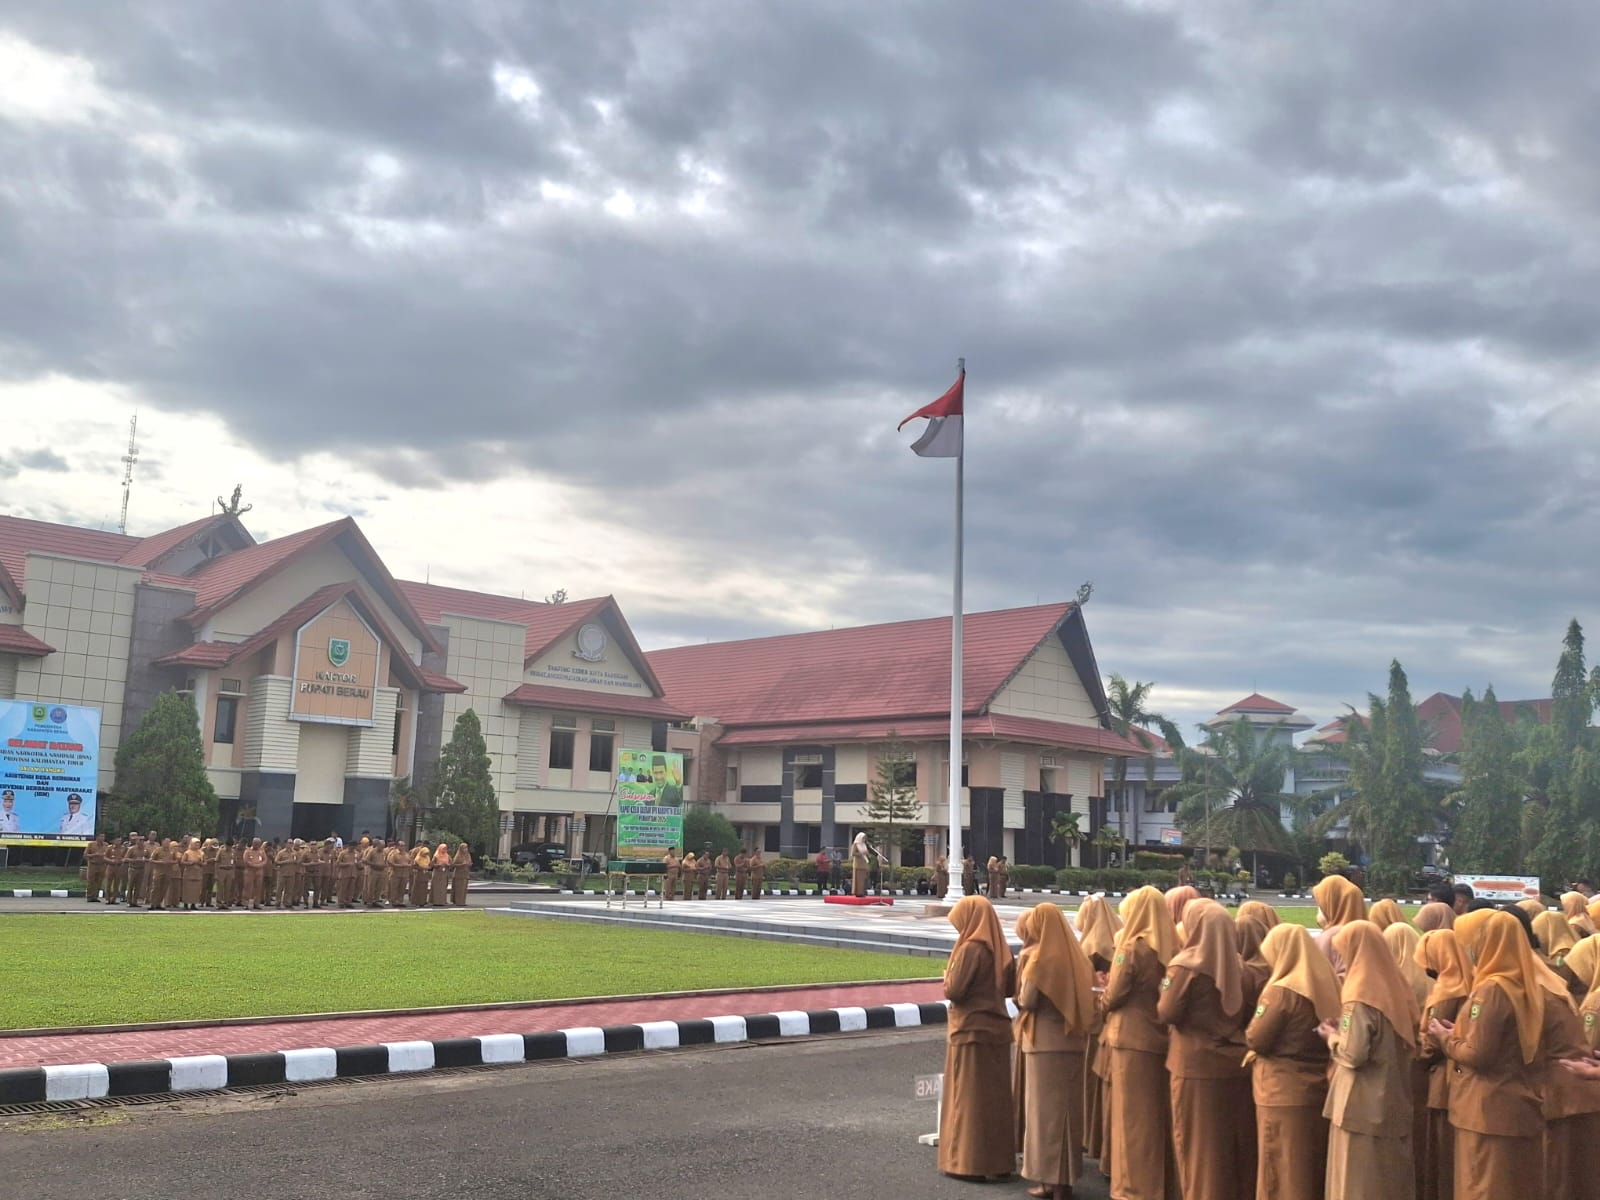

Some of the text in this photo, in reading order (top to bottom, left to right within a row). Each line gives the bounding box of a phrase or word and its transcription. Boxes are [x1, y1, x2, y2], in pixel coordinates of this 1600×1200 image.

[315, 671, 357, 684] KANTOR
[300, 682, 369, 699] BUPATI BERAU
